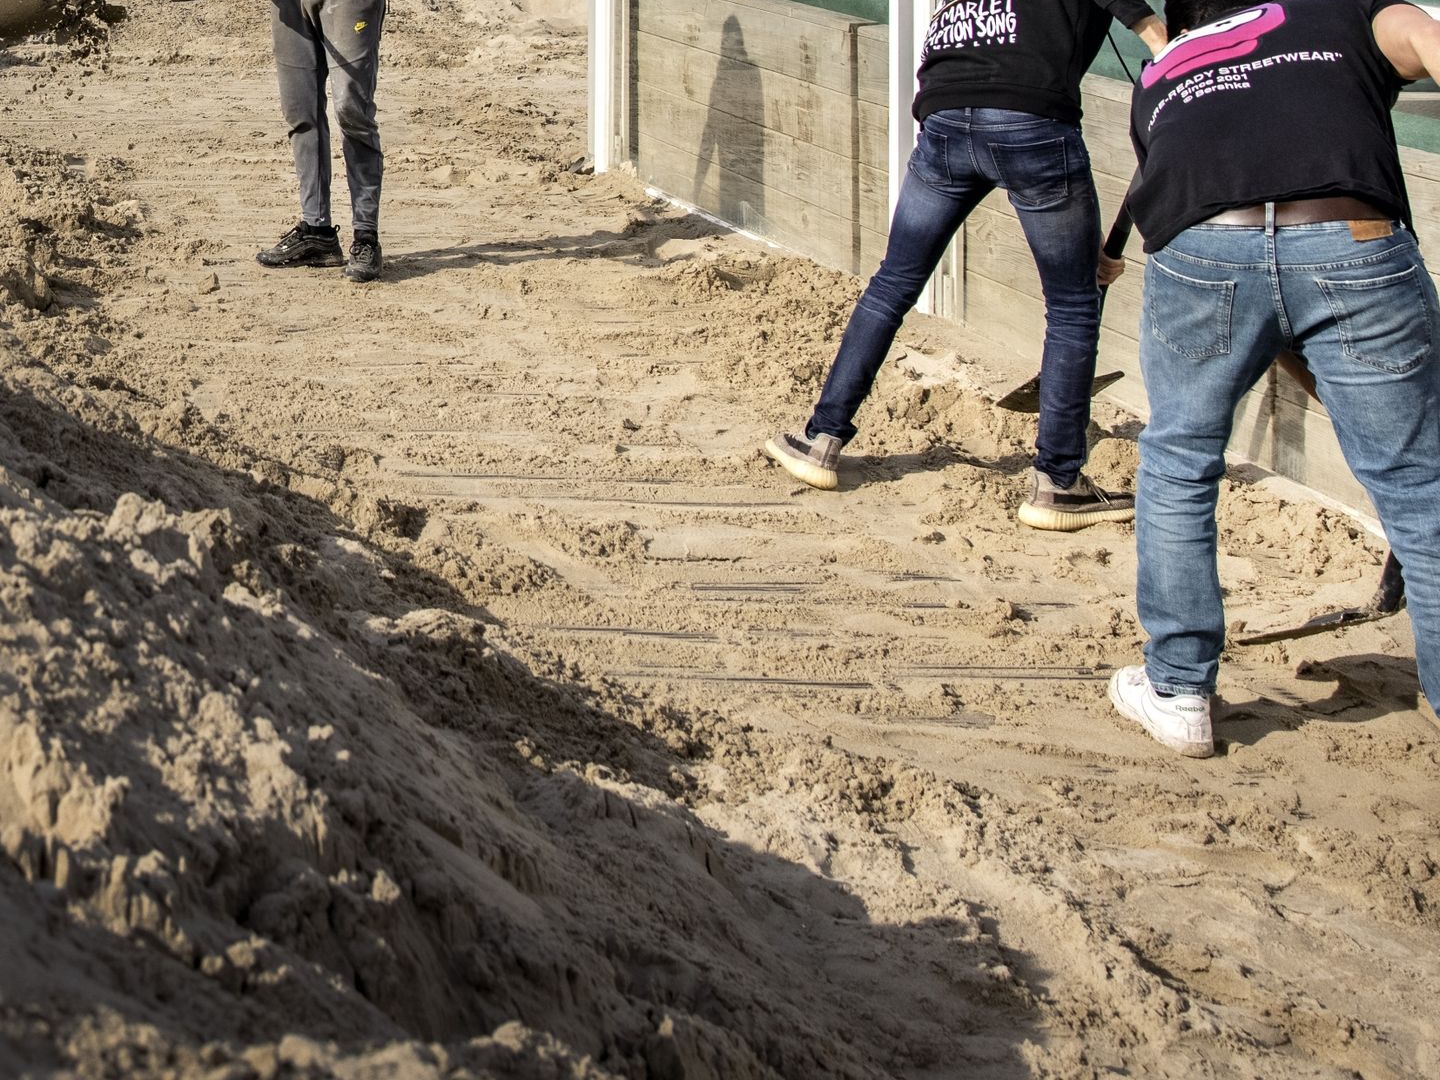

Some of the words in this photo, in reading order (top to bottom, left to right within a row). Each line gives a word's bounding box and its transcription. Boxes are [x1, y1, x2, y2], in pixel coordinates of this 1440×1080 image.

[975, 12, 1017, 38] SONG
[1180, 79, 1214, 98] Since
[1216, 73, 1248, 83] 2001
[1195, 81, 1251, 98] Bershka
